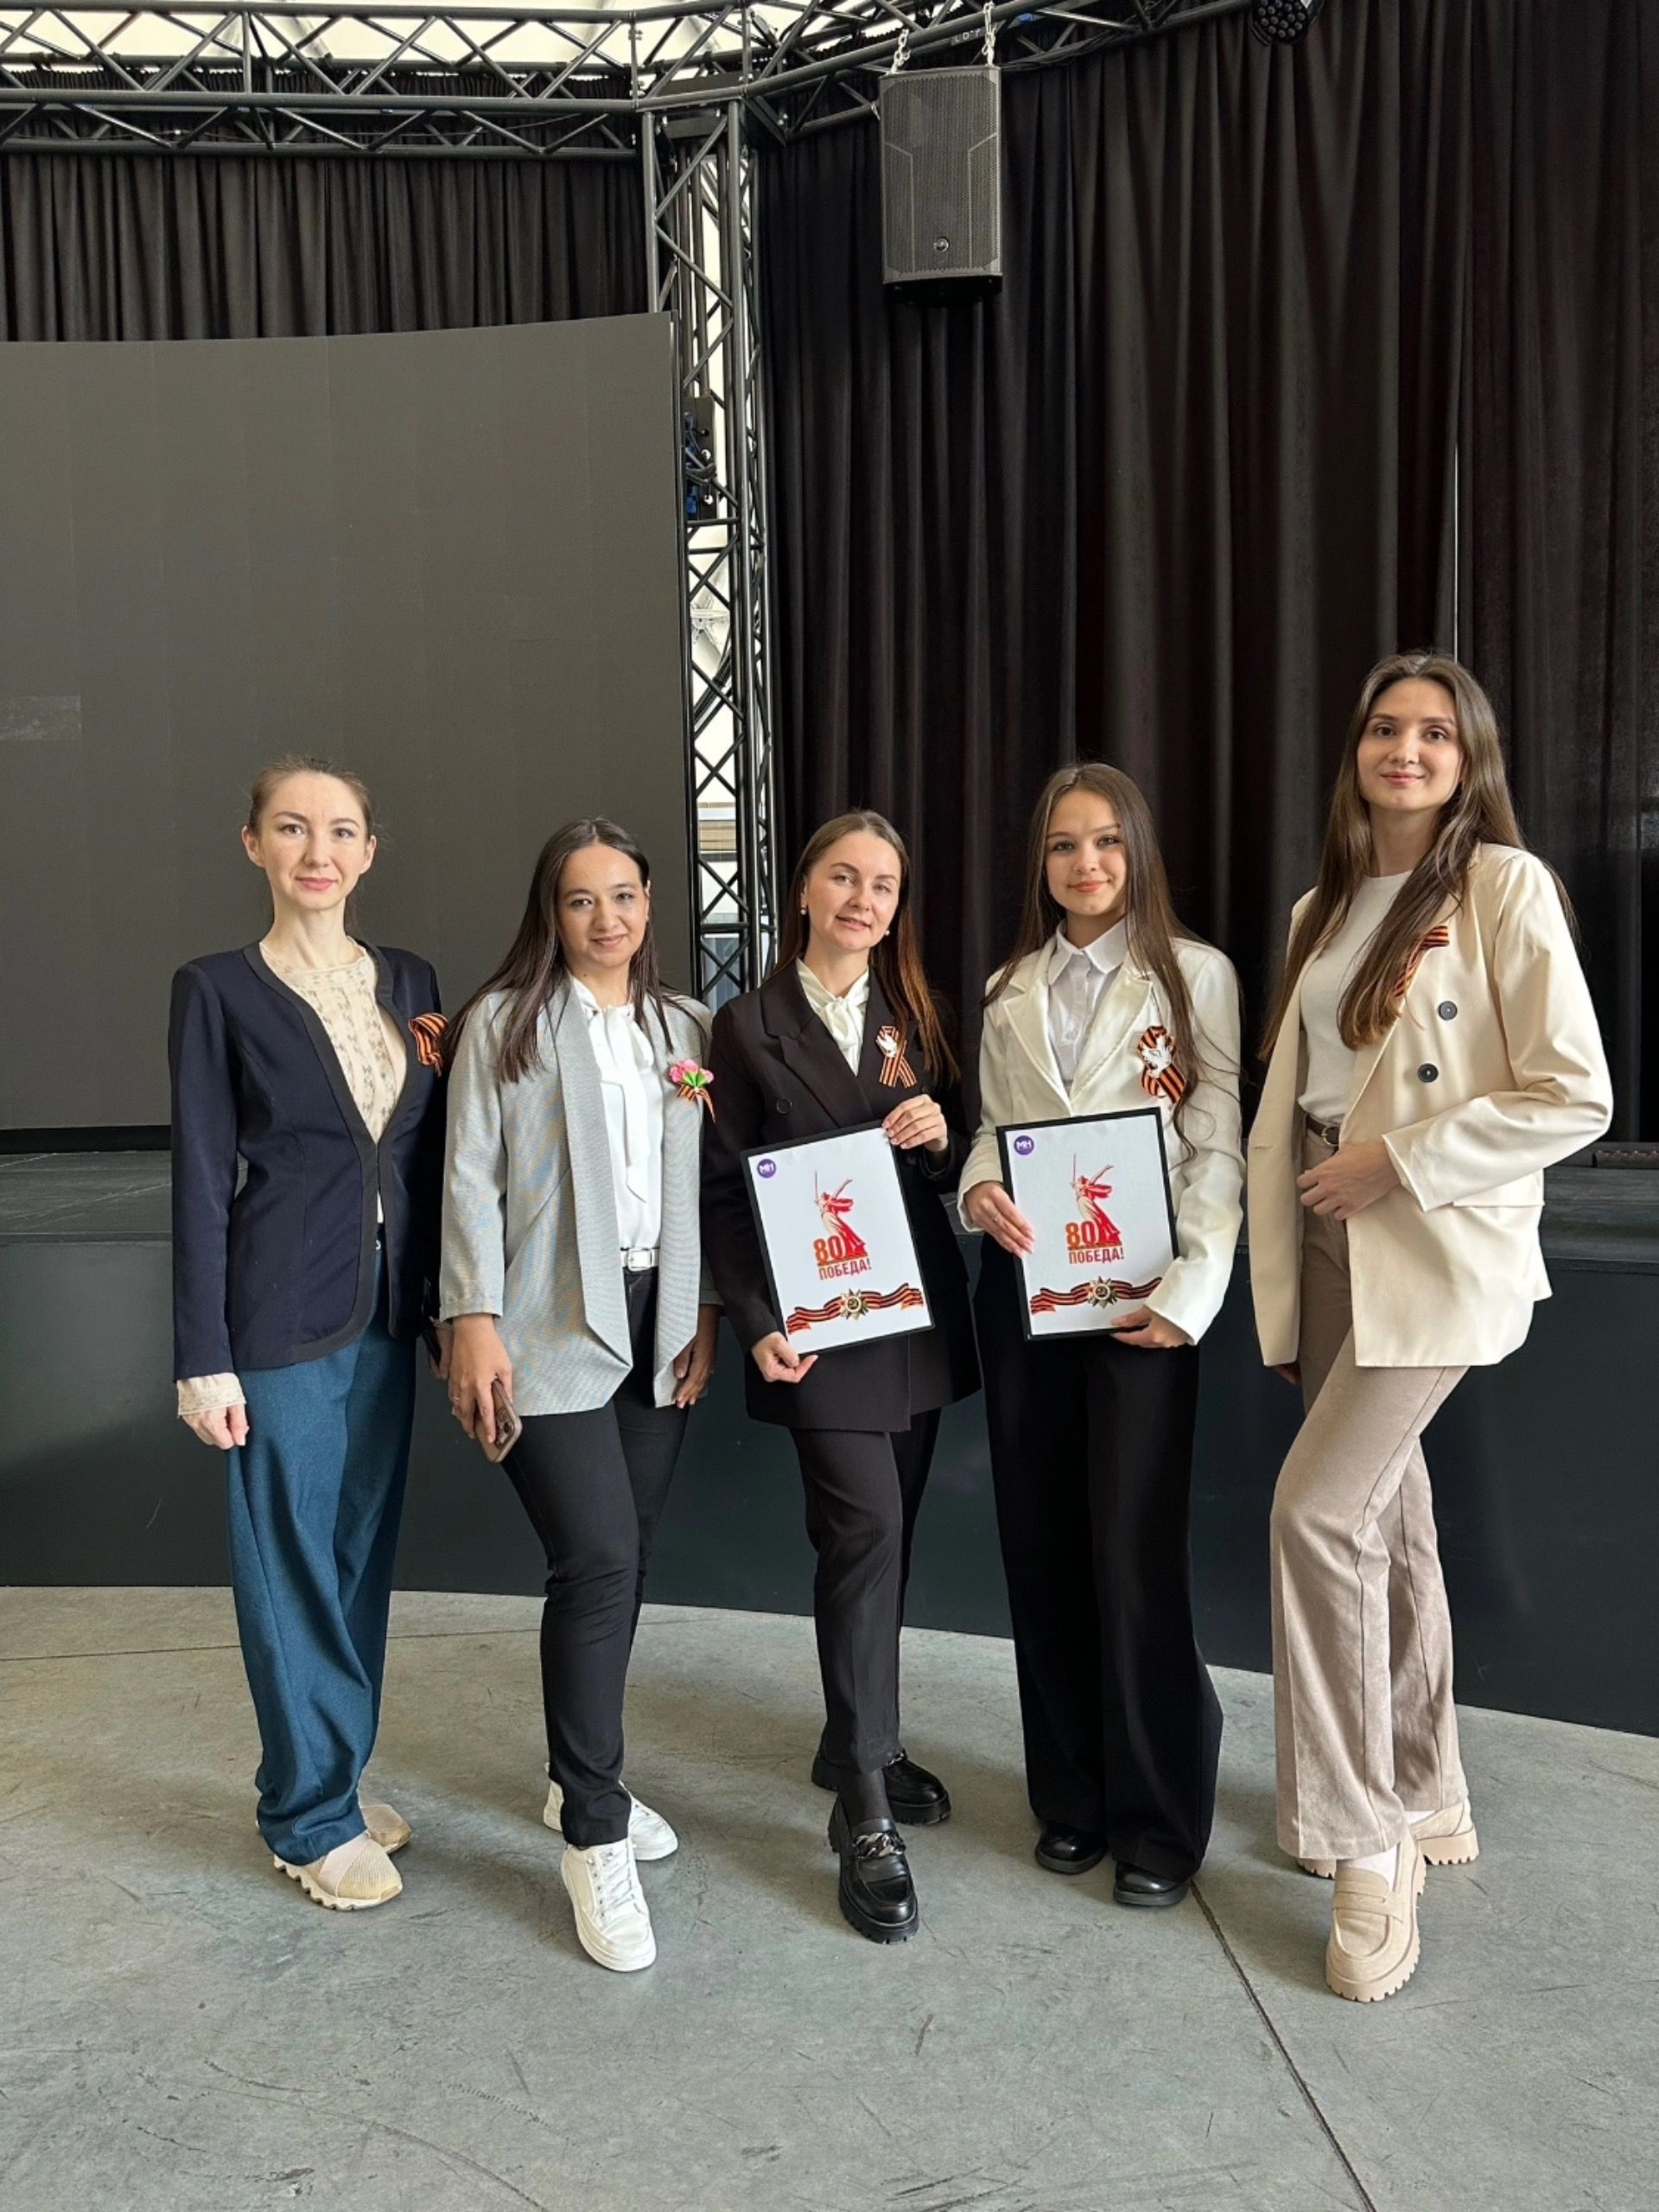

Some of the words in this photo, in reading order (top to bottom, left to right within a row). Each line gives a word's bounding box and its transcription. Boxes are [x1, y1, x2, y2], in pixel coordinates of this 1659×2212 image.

[1065, 1220, 1096, 1248] 80
[813, 1234, 843, 1262] 80
[1068, 1247, 1125, 1264] ПОБЕДА!
[818, 1257, 872, 1281] ПОБЕДА!
